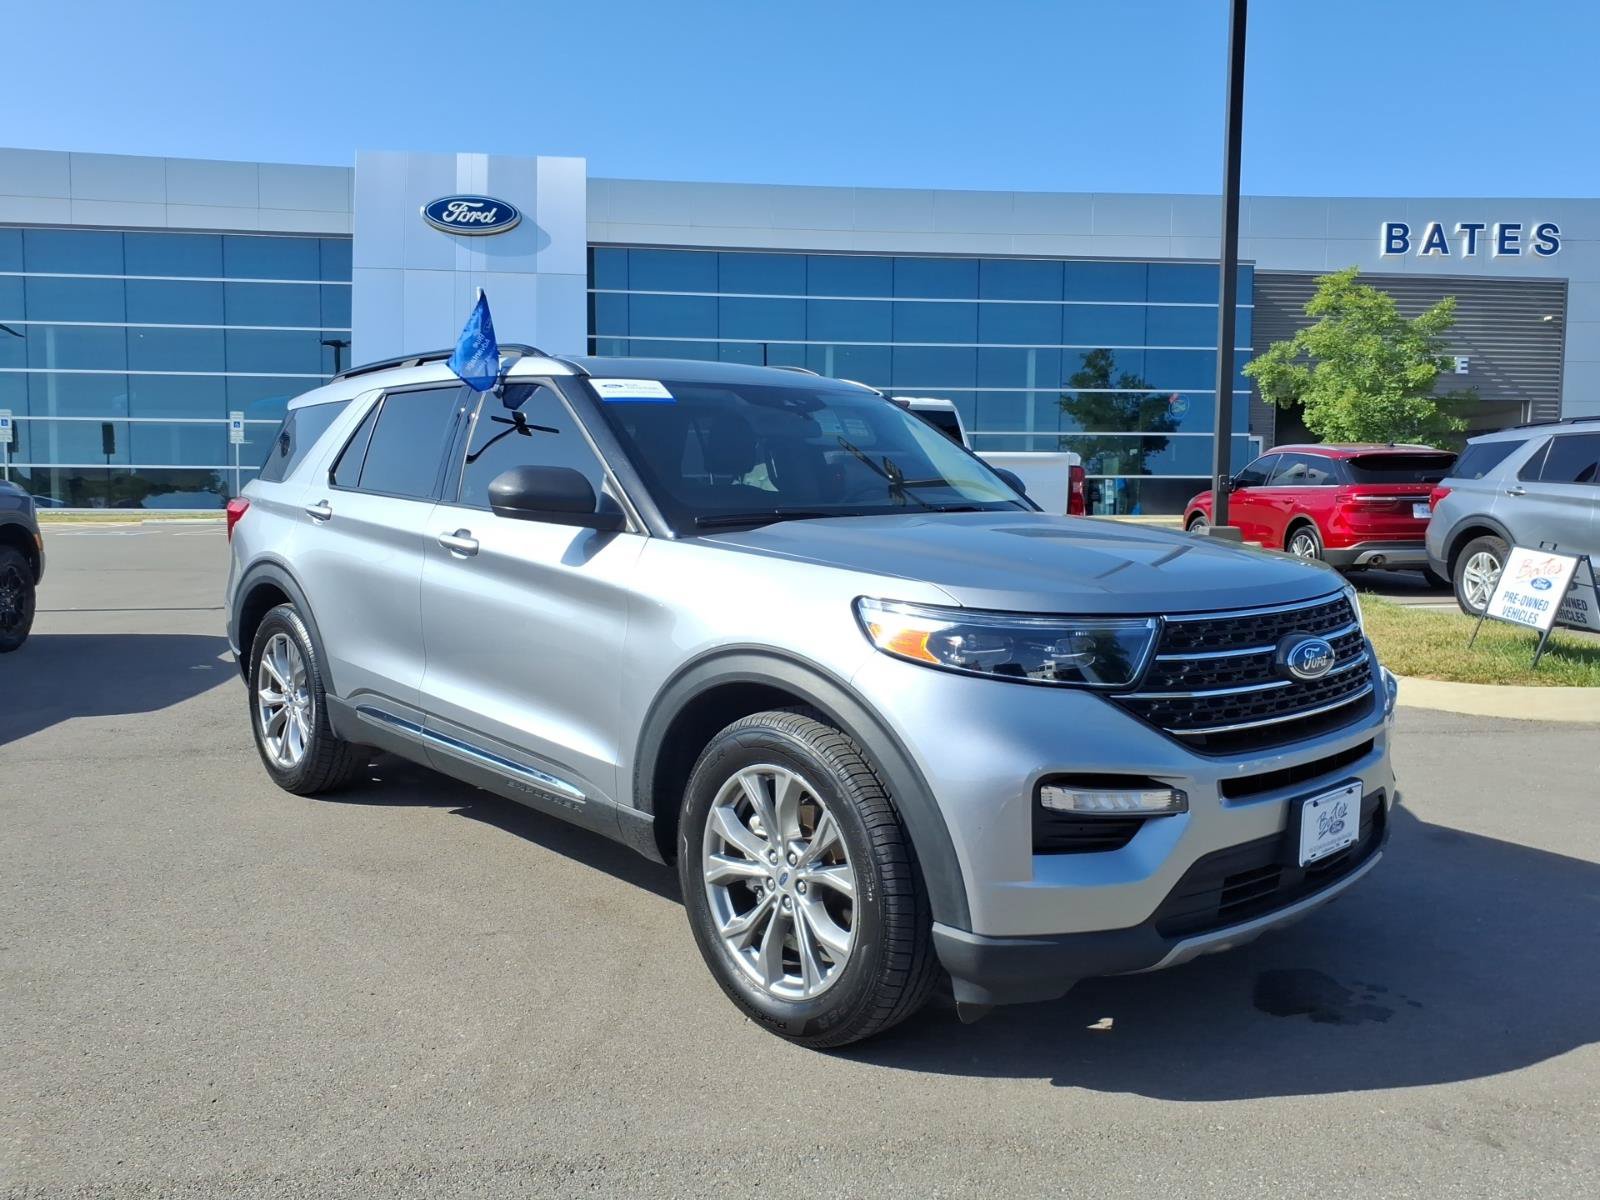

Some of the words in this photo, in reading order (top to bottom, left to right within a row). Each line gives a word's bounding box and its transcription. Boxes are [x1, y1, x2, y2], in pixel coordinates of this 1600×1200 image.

[442, 201, 498, 224] Ford
[1380, 222, 1562, 257] BATES
[1454, 356, 1470, 374] E
[1519, 557, 1563, 578] Bates
[1503, 591, 1549, 611] PRE-OWNED
[1502, 605, 1539, 624] VEHICLES
[1558, 608, 1587, 624] HICLES
[1303, 647, 1327, 670] Ford
